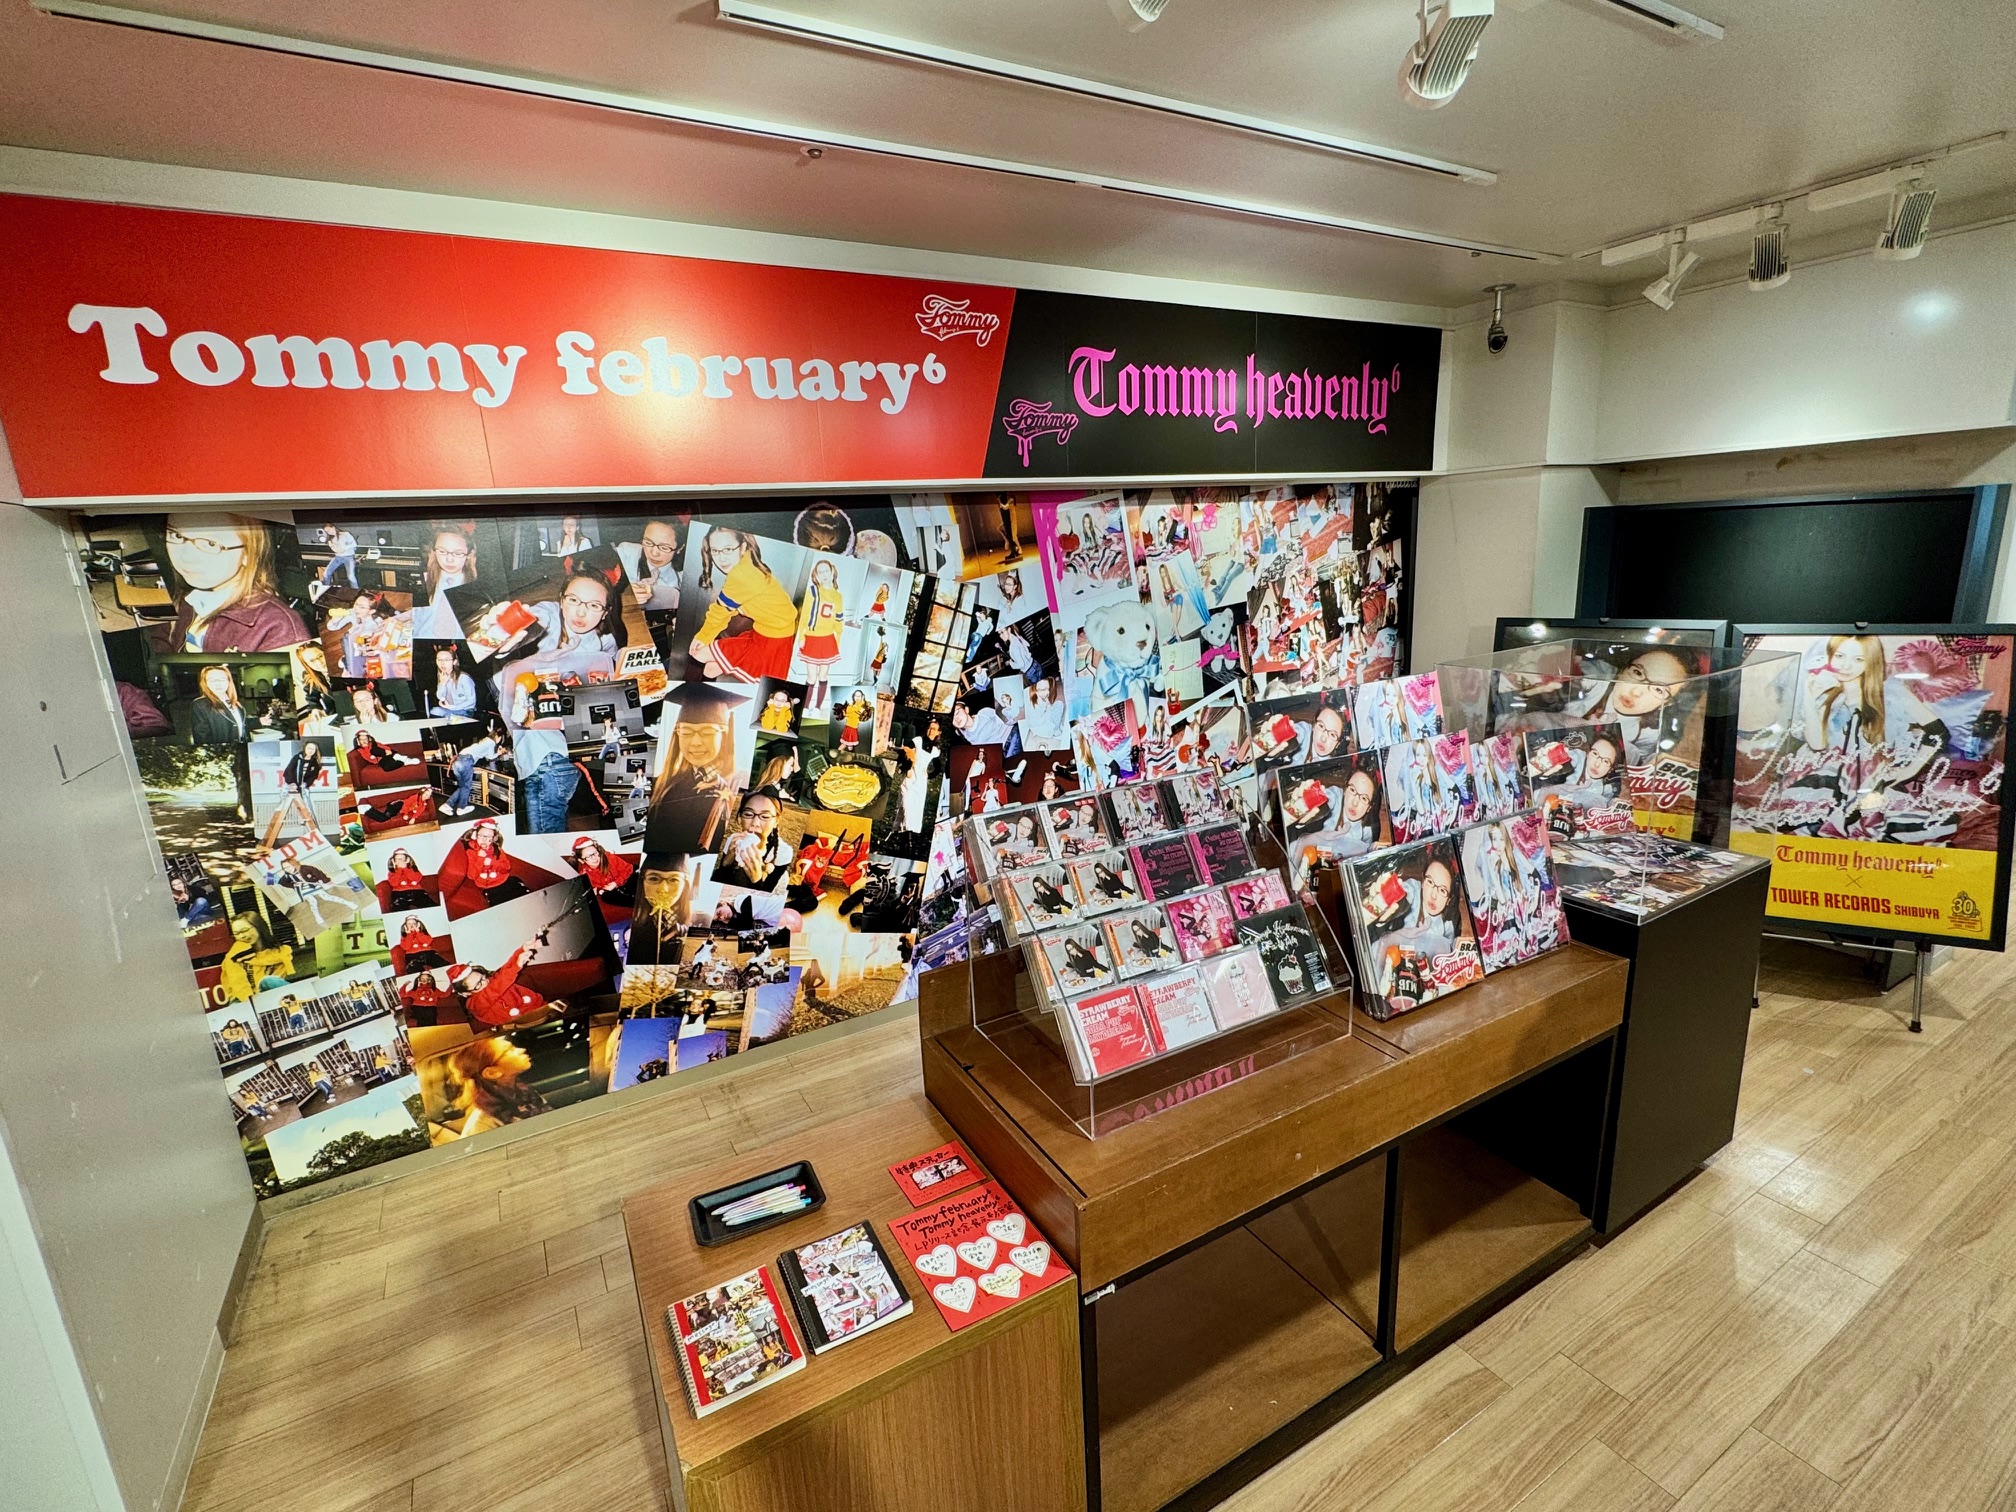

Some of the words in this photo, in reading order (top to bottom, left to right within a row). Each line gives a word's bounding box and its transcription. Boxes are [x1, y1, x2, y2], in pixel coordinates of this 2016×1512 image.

[915, 294, 1000, 347] Tommy
[67, 303, 528, 408] Tommy
[1068, 346, 1239, 435] Tommy
[1002, 398, 1079, 446] Tommy
[1584, 807, 1632, 832] Tommy
[1776, 845, 1849, 871] Tommy
[1770, 887, 1820, 907] TOWER
[1824, 892, 1891, 914] RECORDS
[1894, 905, 1940, 920] SHIBUYA
[1951, 898, 1976, 915] 30
[1431, 950, 1476, 986] Tommy
[1078, 995, 1132, 1018] STRAWBERRY
[1082, 1012, 1109, 1026] CREAM
[1105, 1016, 1122, 1030] POP
[896, 1211, 943, 1236] Tommy
[918, 1217, 956, 1241] Tommy
